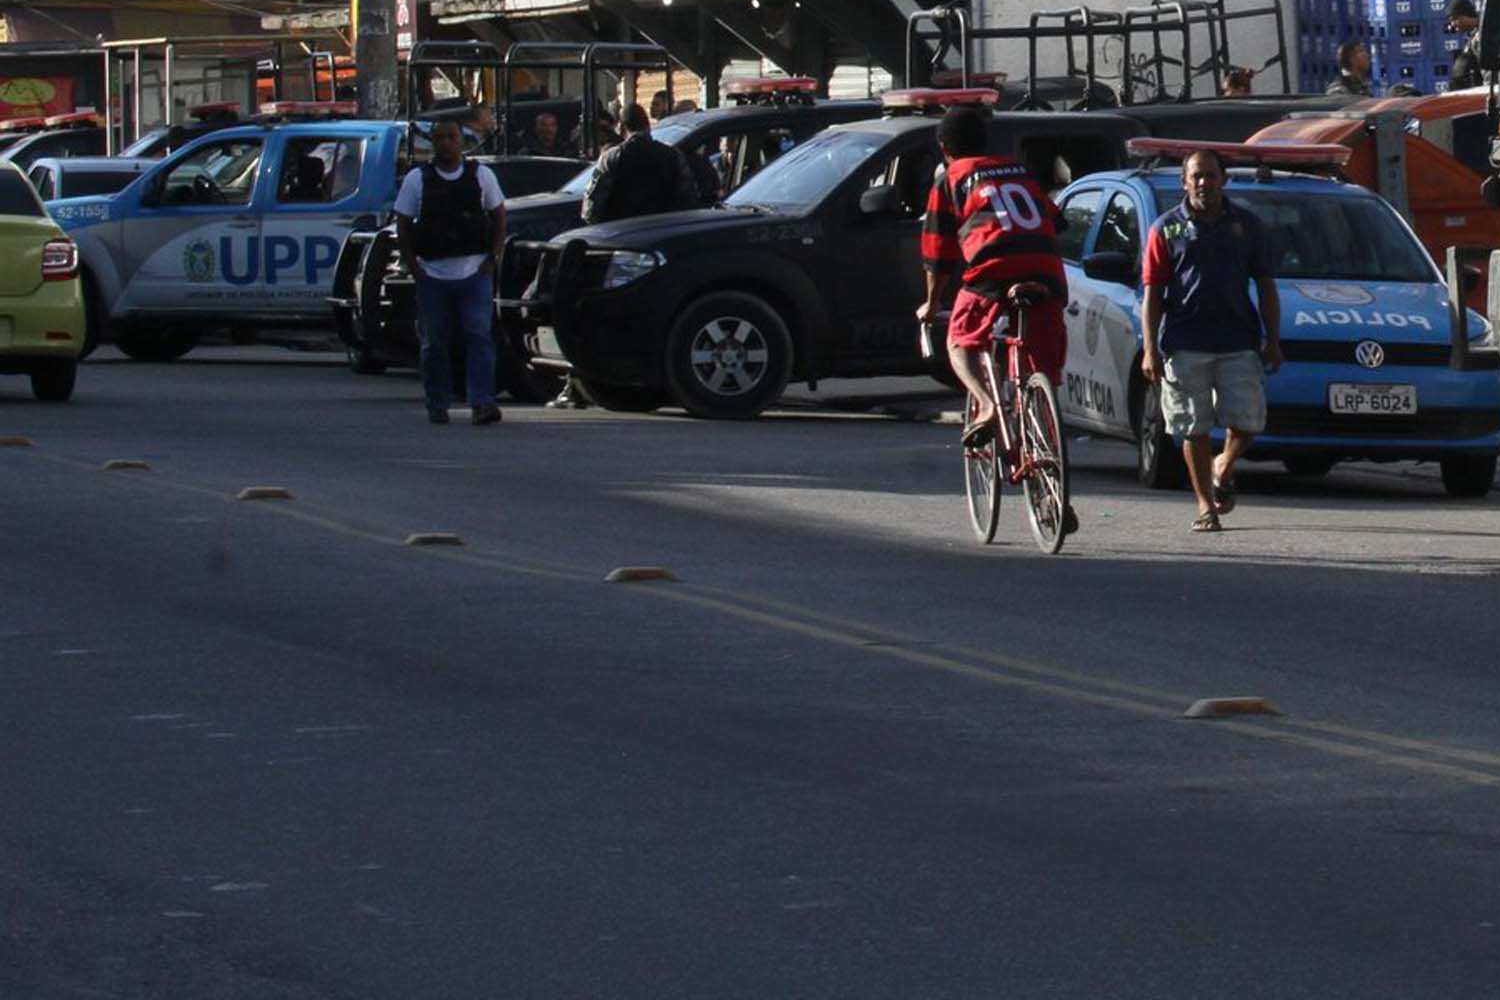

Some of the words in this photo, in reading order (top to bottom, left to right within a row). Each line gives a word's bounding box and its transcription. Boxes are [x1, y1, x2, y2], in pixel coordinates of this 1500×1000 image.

[980, 183, 1042, 232] 10
[220, 235, 342, 285] UPP
[1067, 368, 1116, 418] POLÍCIA
